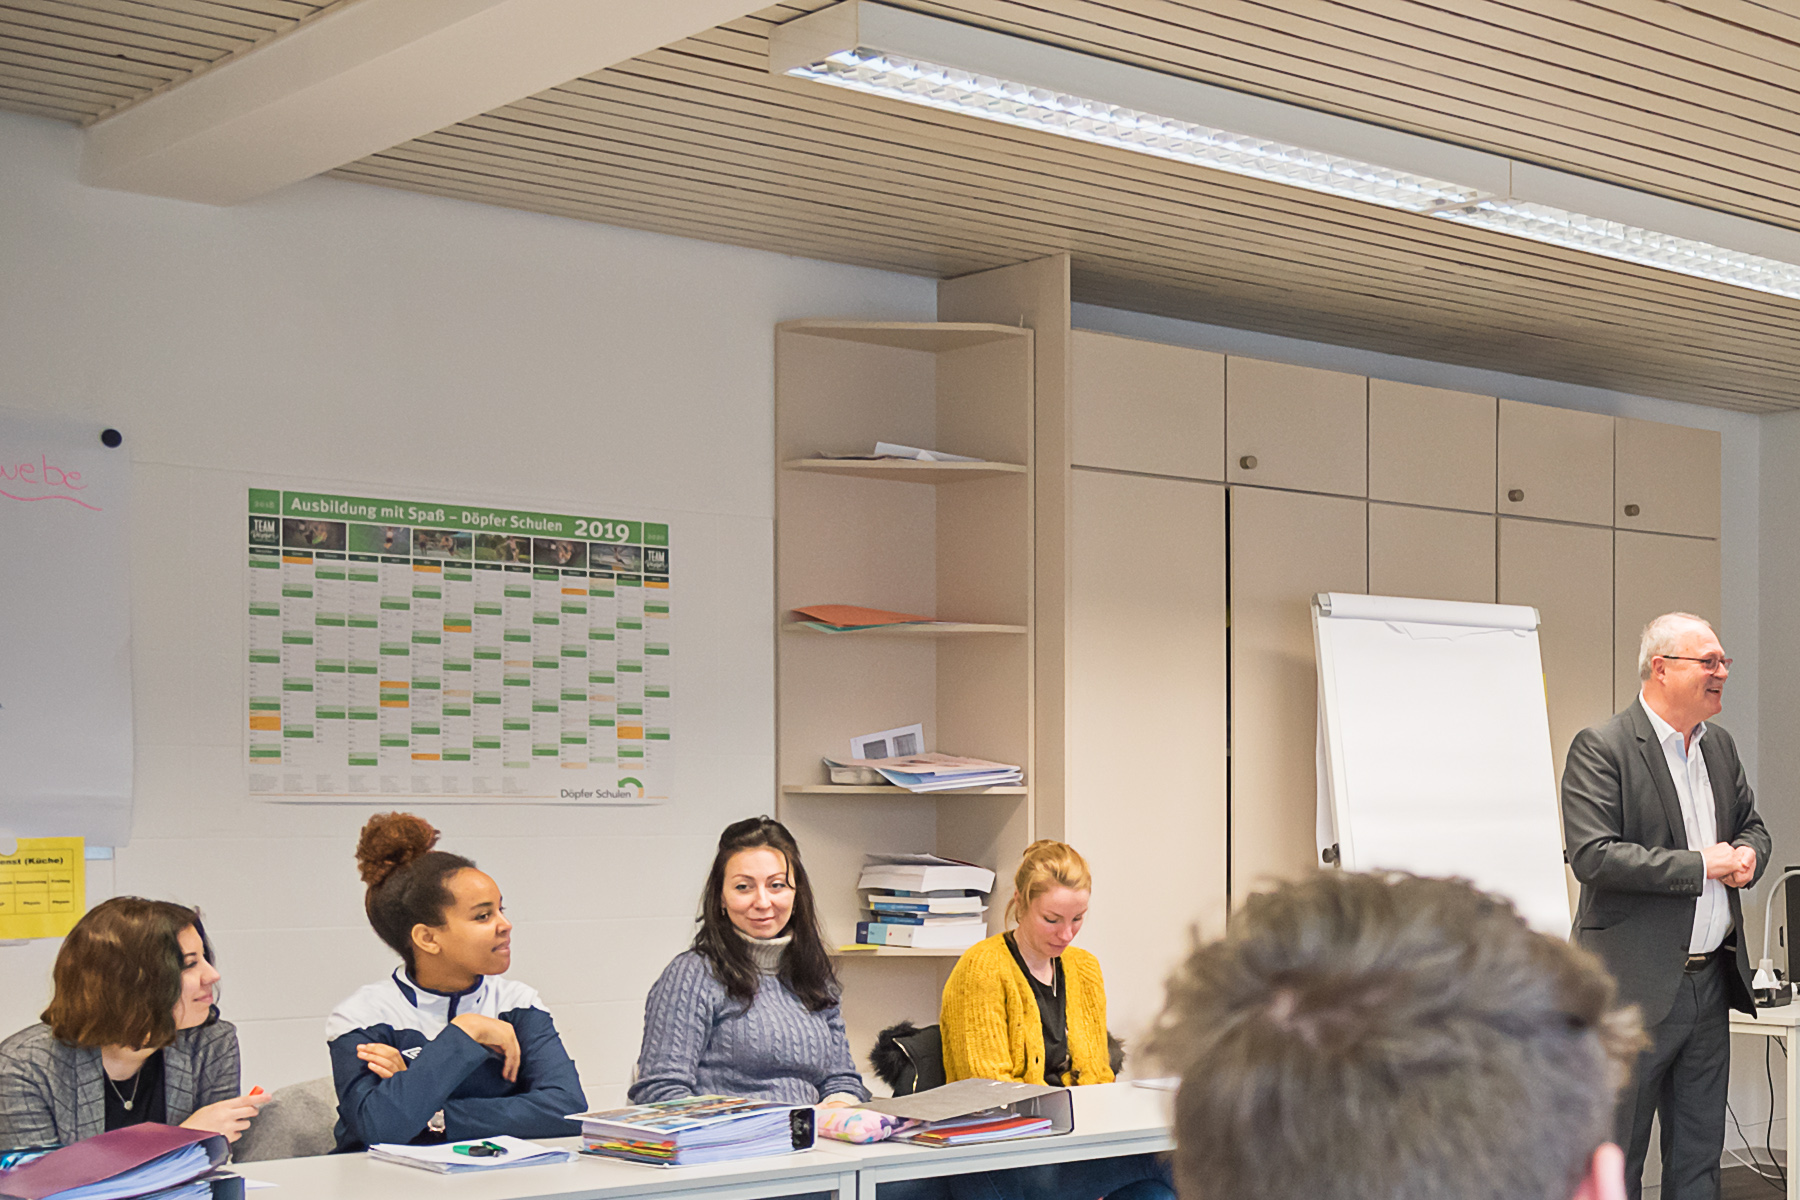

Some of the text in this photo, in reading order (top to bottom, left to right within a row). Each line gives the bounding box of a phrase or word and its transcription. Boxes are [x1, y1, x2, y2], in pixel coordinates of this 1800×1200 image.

[254, 519, 275, 533] TEAM
[291, 497, 377, 519] Ausbildung
[381, 505, 404, 519] mit
[408, 507, 445, 523] Spaß
[462, 511, 506, 528] Döpfer
[510, 515, 563, 532] Schulen
[574, 519, 630, 543] 2019
[560, 789, 631, 800] Döpfer Schulen
[24, 857, 63, 866] (Küche)
